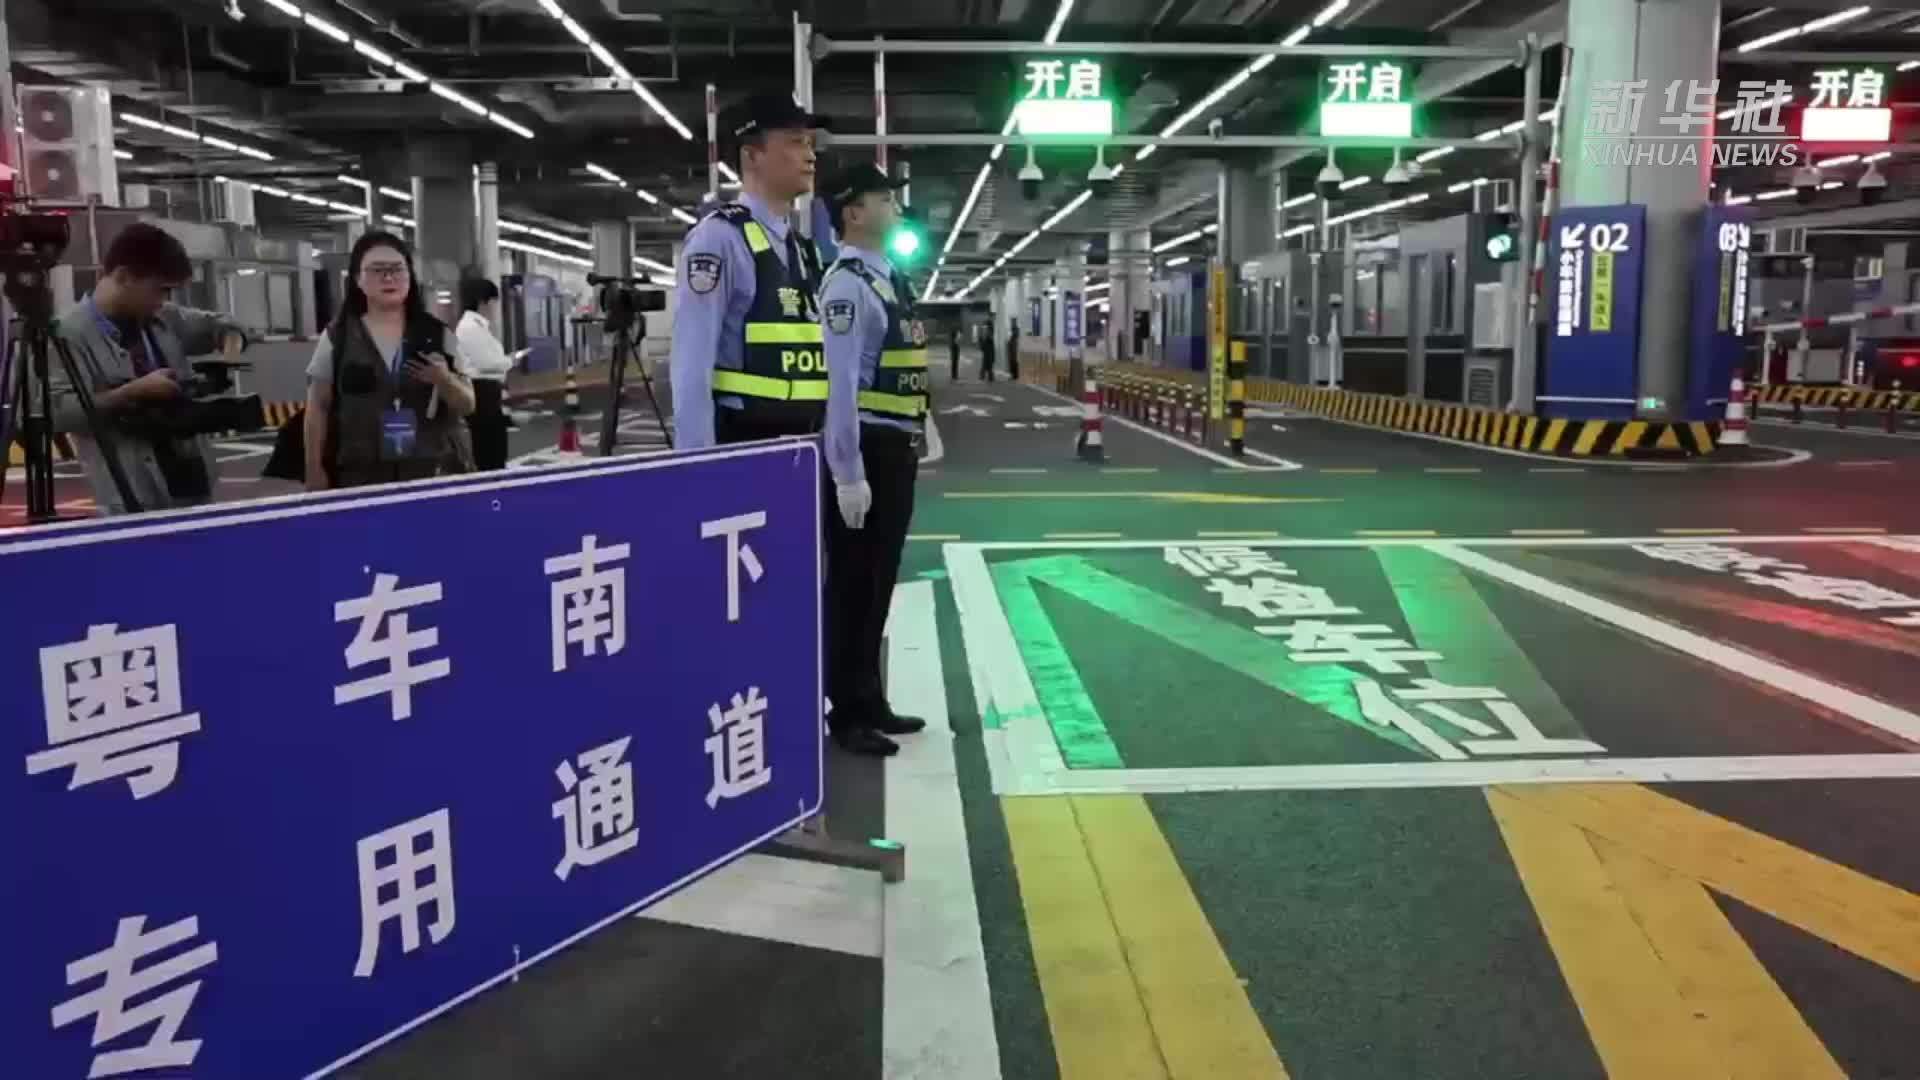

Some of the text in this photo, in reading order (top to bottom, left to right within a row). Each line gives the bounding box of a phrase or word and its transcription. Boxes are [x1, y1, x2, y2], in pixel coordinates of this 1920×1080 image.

[1025, 60, 1102, 98] 开启
[1327, 62, 1403, 101] 开启
[1808, 69, 1885, 107] 开启
[1590, 223, 1630, 252] 02
[25, 511, 767, 800] 粤车南下
[51, 686, 772, 1079] 专用通道
